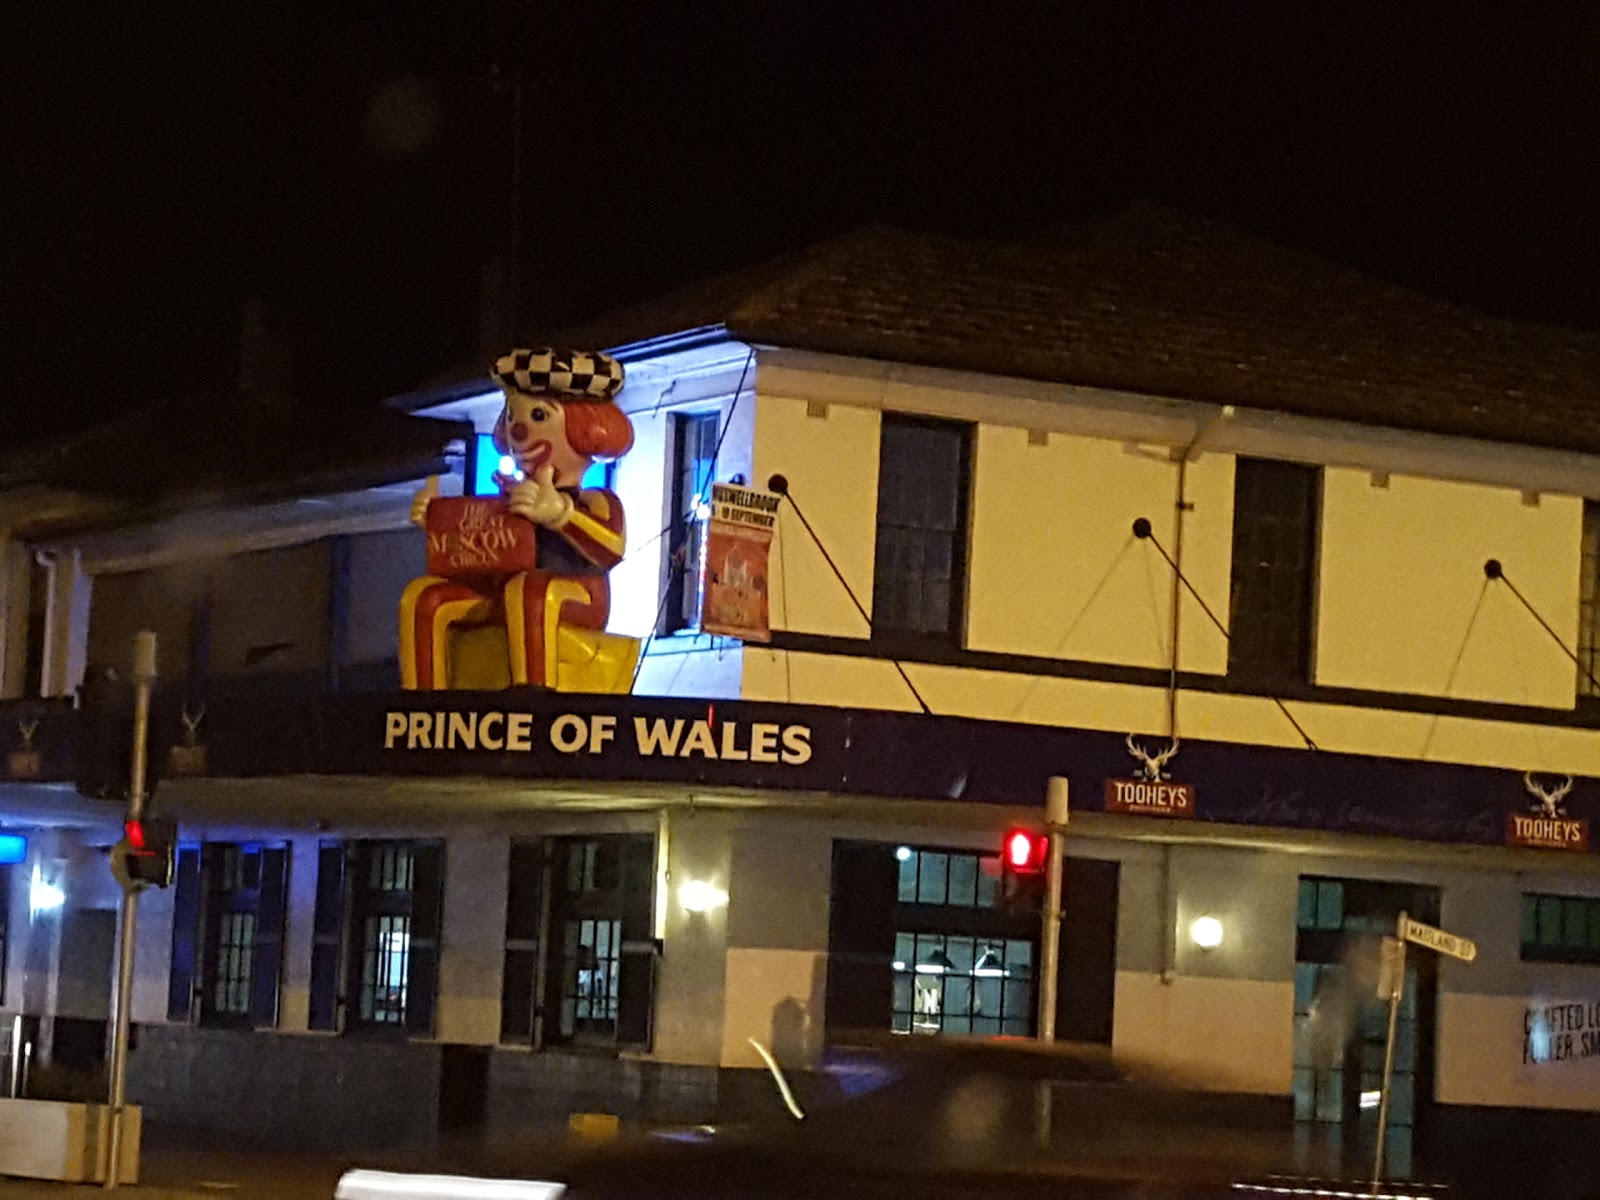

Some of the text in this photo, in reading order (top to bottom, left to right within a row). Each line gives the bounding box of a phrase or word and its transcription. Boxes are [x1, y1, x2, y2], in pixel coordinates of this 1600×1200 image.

[731, 508, 775, 528] SEPTEMBER
[429, 528, 517, 562] MSCOW
[384, 711, 812, 765] PRINCE OF WALES
[1113, 781, 1187, 808] TOOHEYS
[1513, 815, 1581, 842] TOOHEYS
[1409, 924, 1457, 952] MAITLAND
